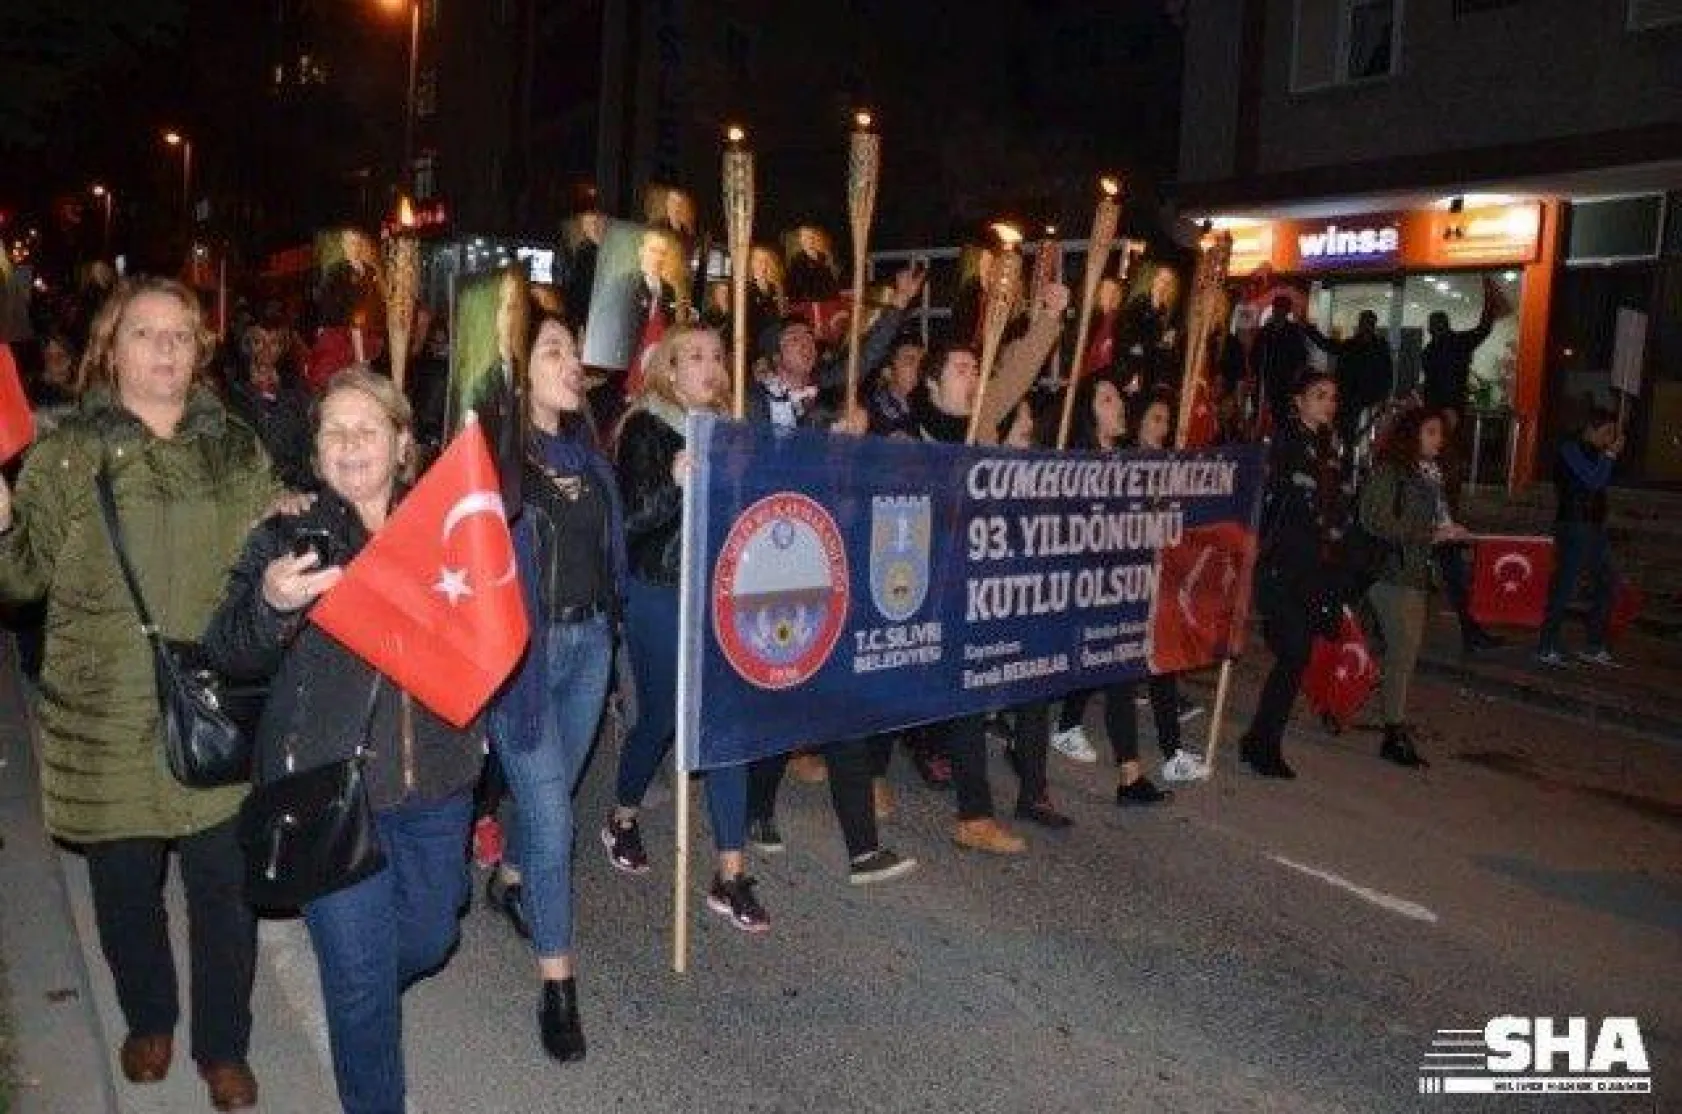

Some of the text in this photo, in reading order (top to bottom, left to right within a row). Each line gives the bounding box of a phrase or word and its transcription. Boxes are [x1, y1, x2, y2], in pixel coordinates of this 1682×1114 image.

[967, 503, 1184, 561] 93. YILDÖNÜMÜ
[966, 563, 1158, 622] KUTLU OLSUN
